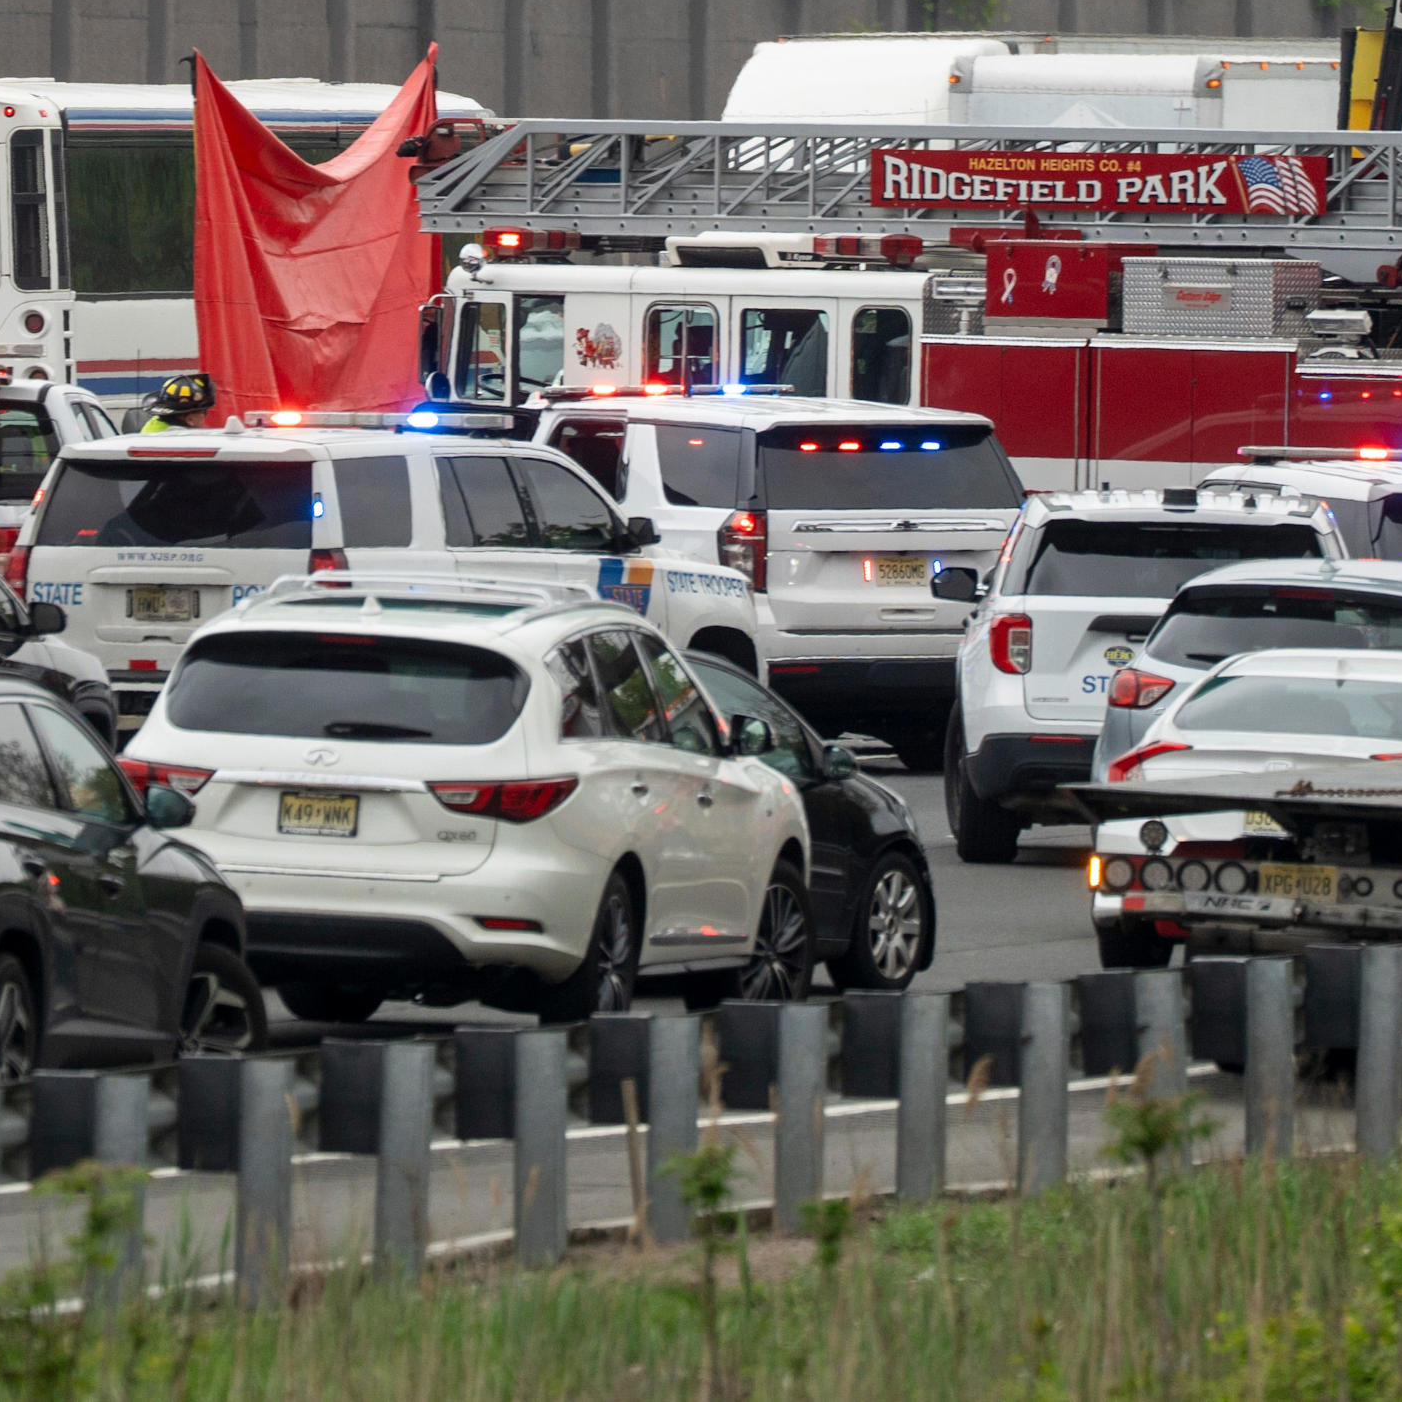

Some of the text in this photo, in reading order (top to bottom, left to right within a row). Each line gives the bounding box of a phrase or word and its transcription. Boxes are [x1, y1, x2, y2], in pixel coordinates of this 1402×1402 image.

[968, 156, 1142, 173] HAZELTON HEIGHTS CO. #4
[882, 154, 1229, 206] RIDGEFIELD PARK
[116, 551, 205, 563] WWW.NJSP.ORG
[31, 582, 83, 606] STATE
[666, 569, 747, 599] STATE TROOPER
